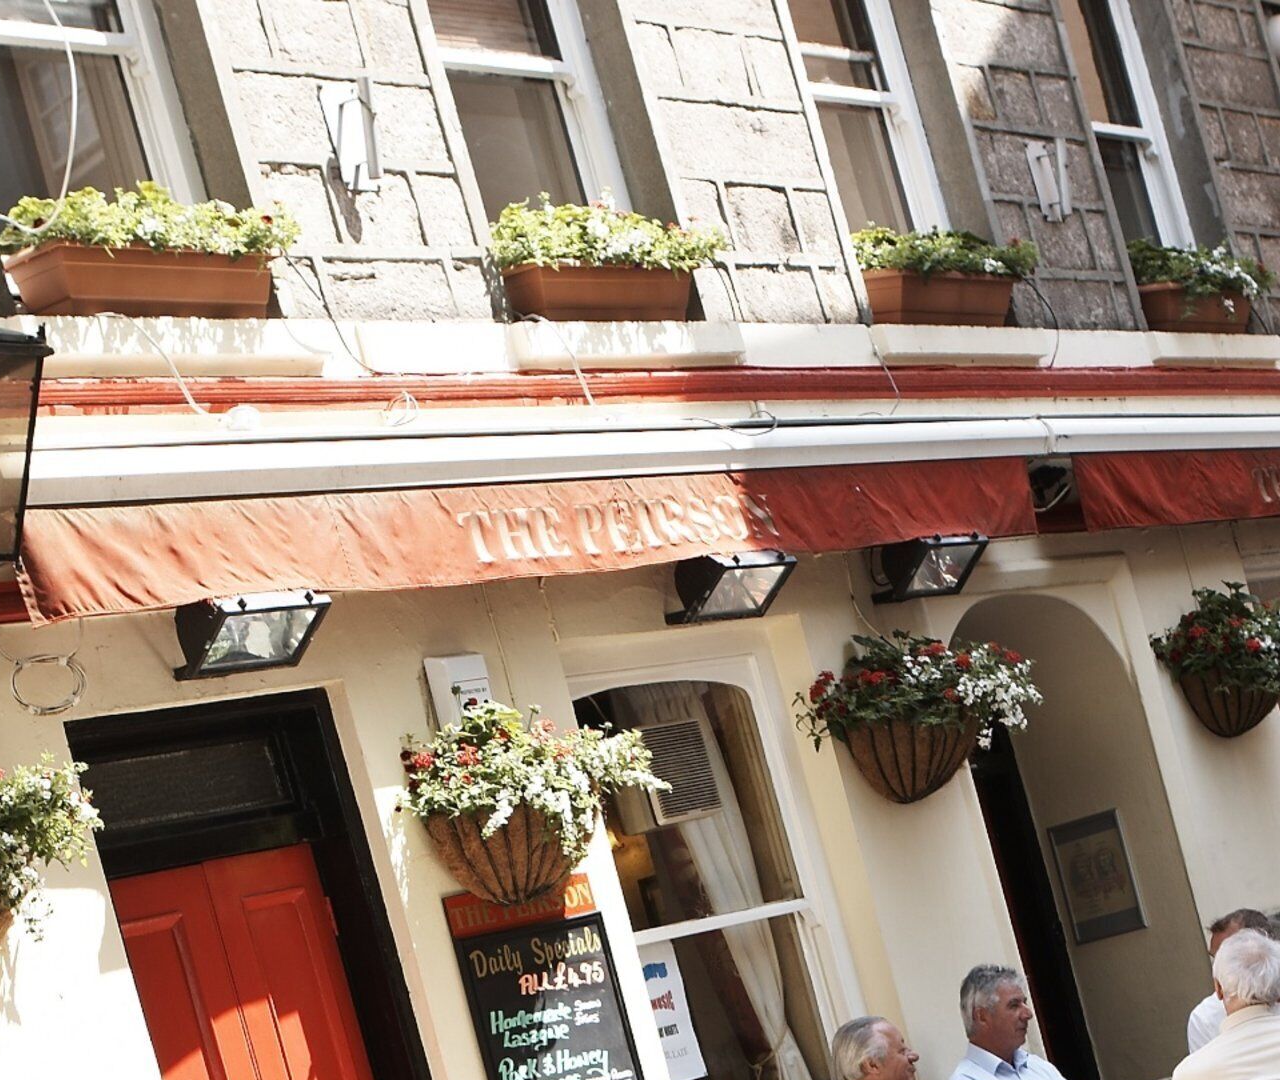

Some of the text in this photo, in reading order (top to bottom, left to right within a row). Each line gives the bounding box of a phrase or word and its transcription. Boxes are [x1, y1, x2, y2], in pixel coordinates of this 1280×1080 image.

[457, 494, 780, 564] THE PEIRSON
[450, 902, 499, 930] THE
[469, 926, 602, 979] Daily Specials
